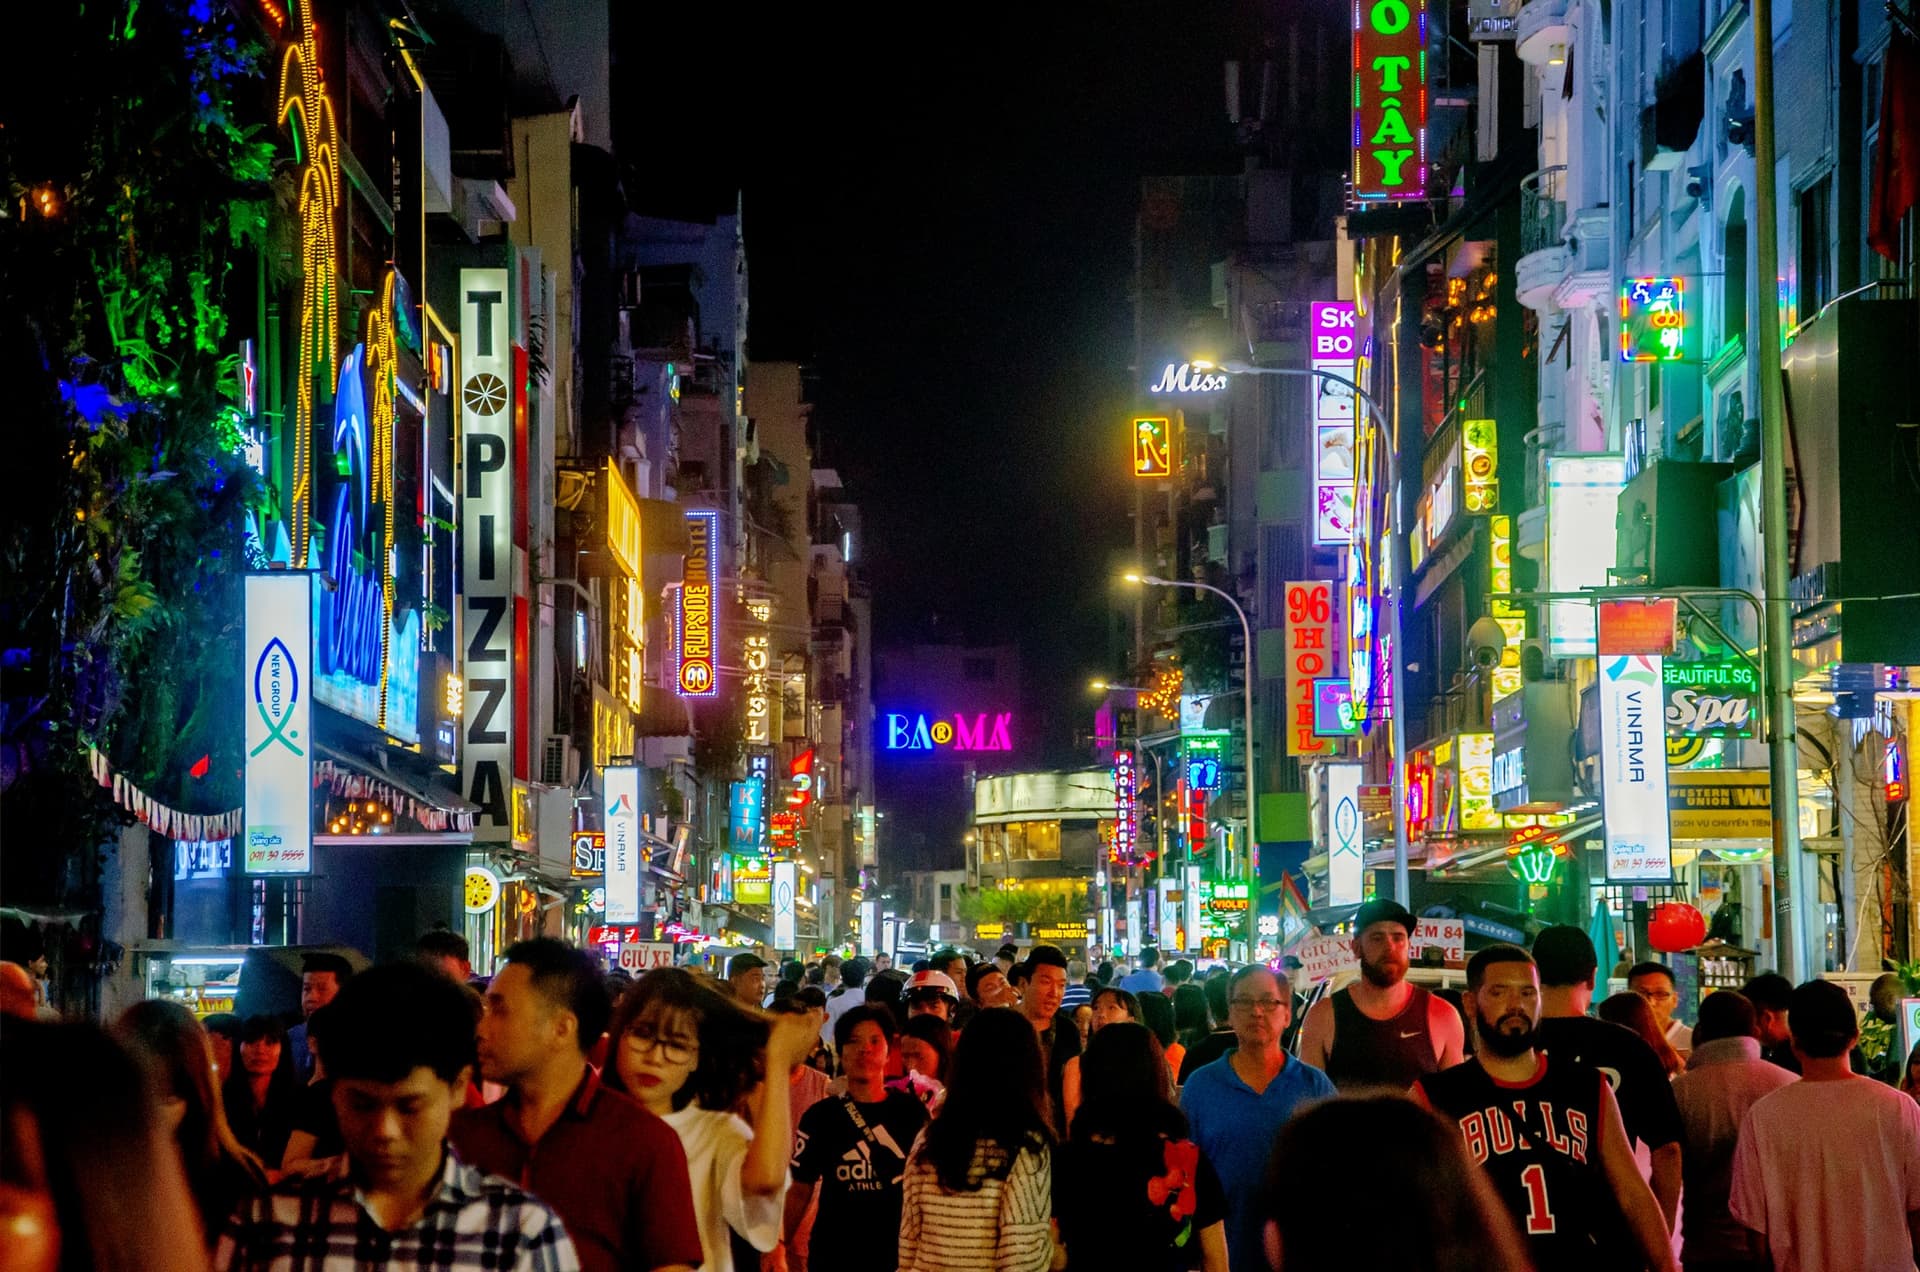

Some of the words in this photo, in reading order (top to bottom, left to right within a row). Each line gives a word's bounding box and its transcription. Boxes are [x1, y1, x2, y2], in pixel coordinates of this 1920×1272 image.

[1150, 363, 1227, 393] Miss
[687, 519, 708, 580] HOSTEL
[683, 585, 709, 658] FLIPSIDE
[1288, 587, 1329, 623] 96
[271, 654, 281, 679] NEW
[1663, 669, 1731, 683] BEAUTIFUL
[1733, 669, 1752, 683] SG
[271, 680, 281, 717] GROUP
[1665, 690, 1750, 731] Spa
[1626, 690, 1645, 782] VINAMA
[736, 787, 755, 844] KIM
[1687, 797, 1730, 806] UNION
[617, 822, 626, 872] VINAMA
[1443, 926, 1463, 939] 84
[836, 1160, 877, 1180] adi
[848, 1181, 883, 1191] ATHLE
[1521, 1164, 1555, 1234] 1
